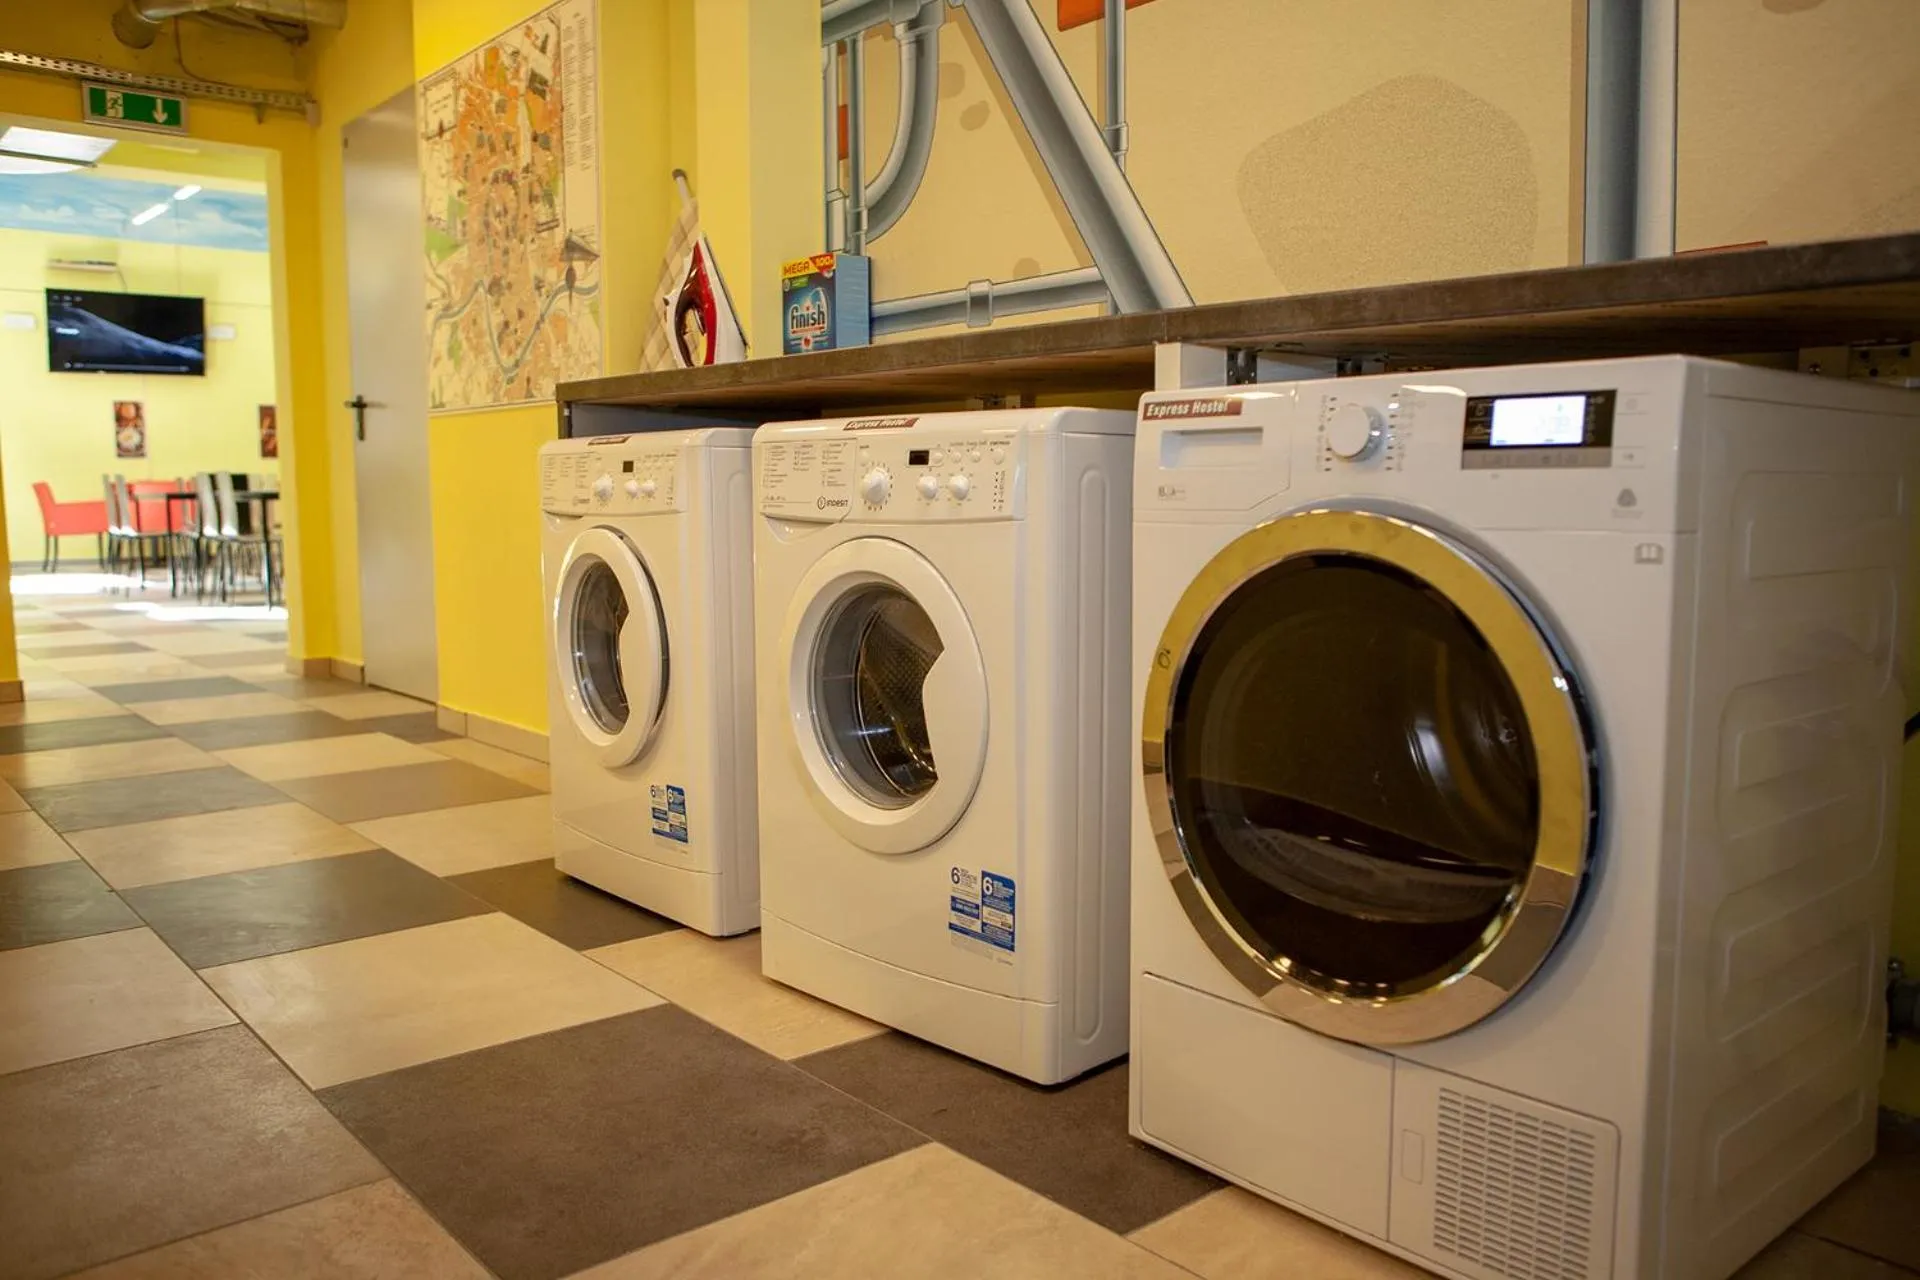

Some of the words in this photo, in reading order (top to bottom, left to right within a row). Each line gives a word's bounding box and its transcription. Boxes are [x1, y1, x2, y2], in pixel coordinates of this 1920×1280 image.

[783, 261, 810, 276] MEGA
[791, 303, 826, 329] finish
[1146, 403, 1190, 418] Express
[1192, 398, 1232, 414] Hostel
[951, 867, 960, 884] 6
[983, 877, 993, 895] 6
